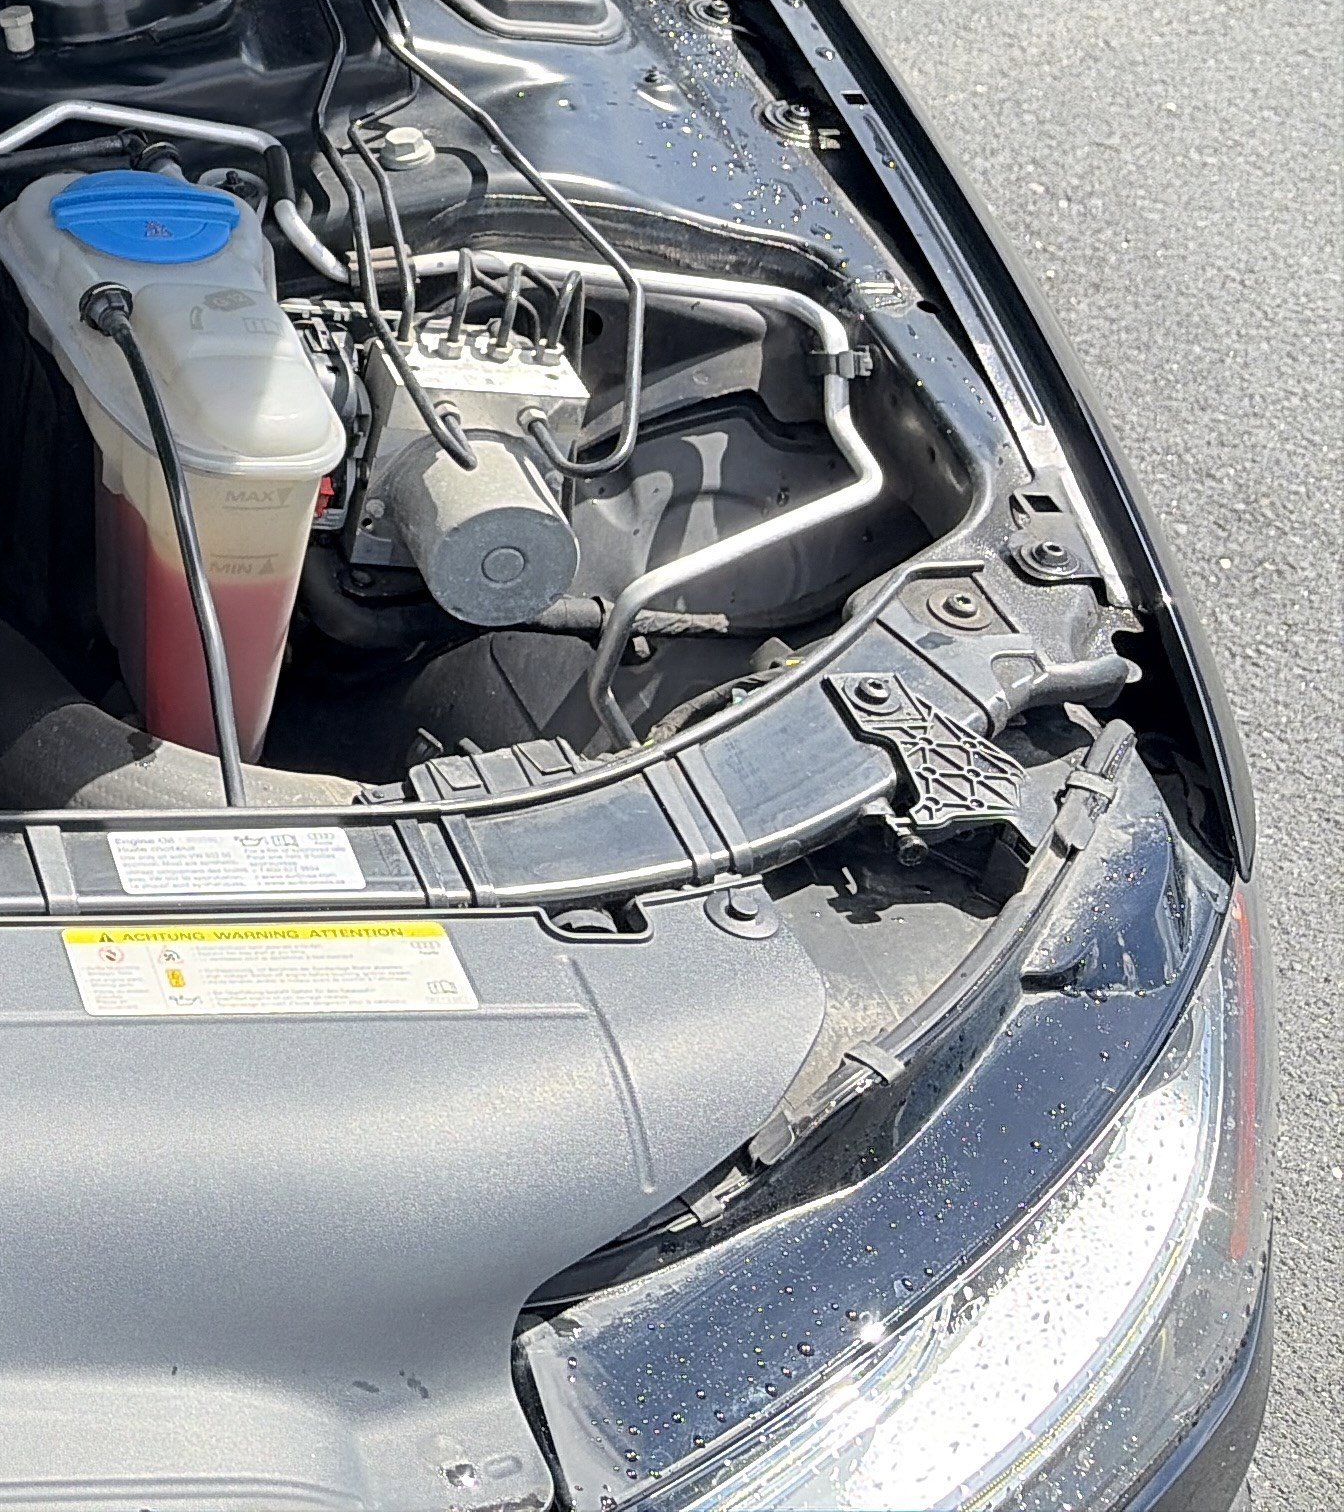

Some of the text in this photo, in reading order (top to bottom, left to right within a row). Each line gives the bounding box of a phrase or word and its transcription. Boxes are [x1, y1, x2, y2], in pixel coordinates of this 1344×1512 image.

[225, 489, 273, 502] MAX
[210, 560, 252, 574] MIN
[122, 927, 404, 941] ACHTUNG WARNING ATTENTION
